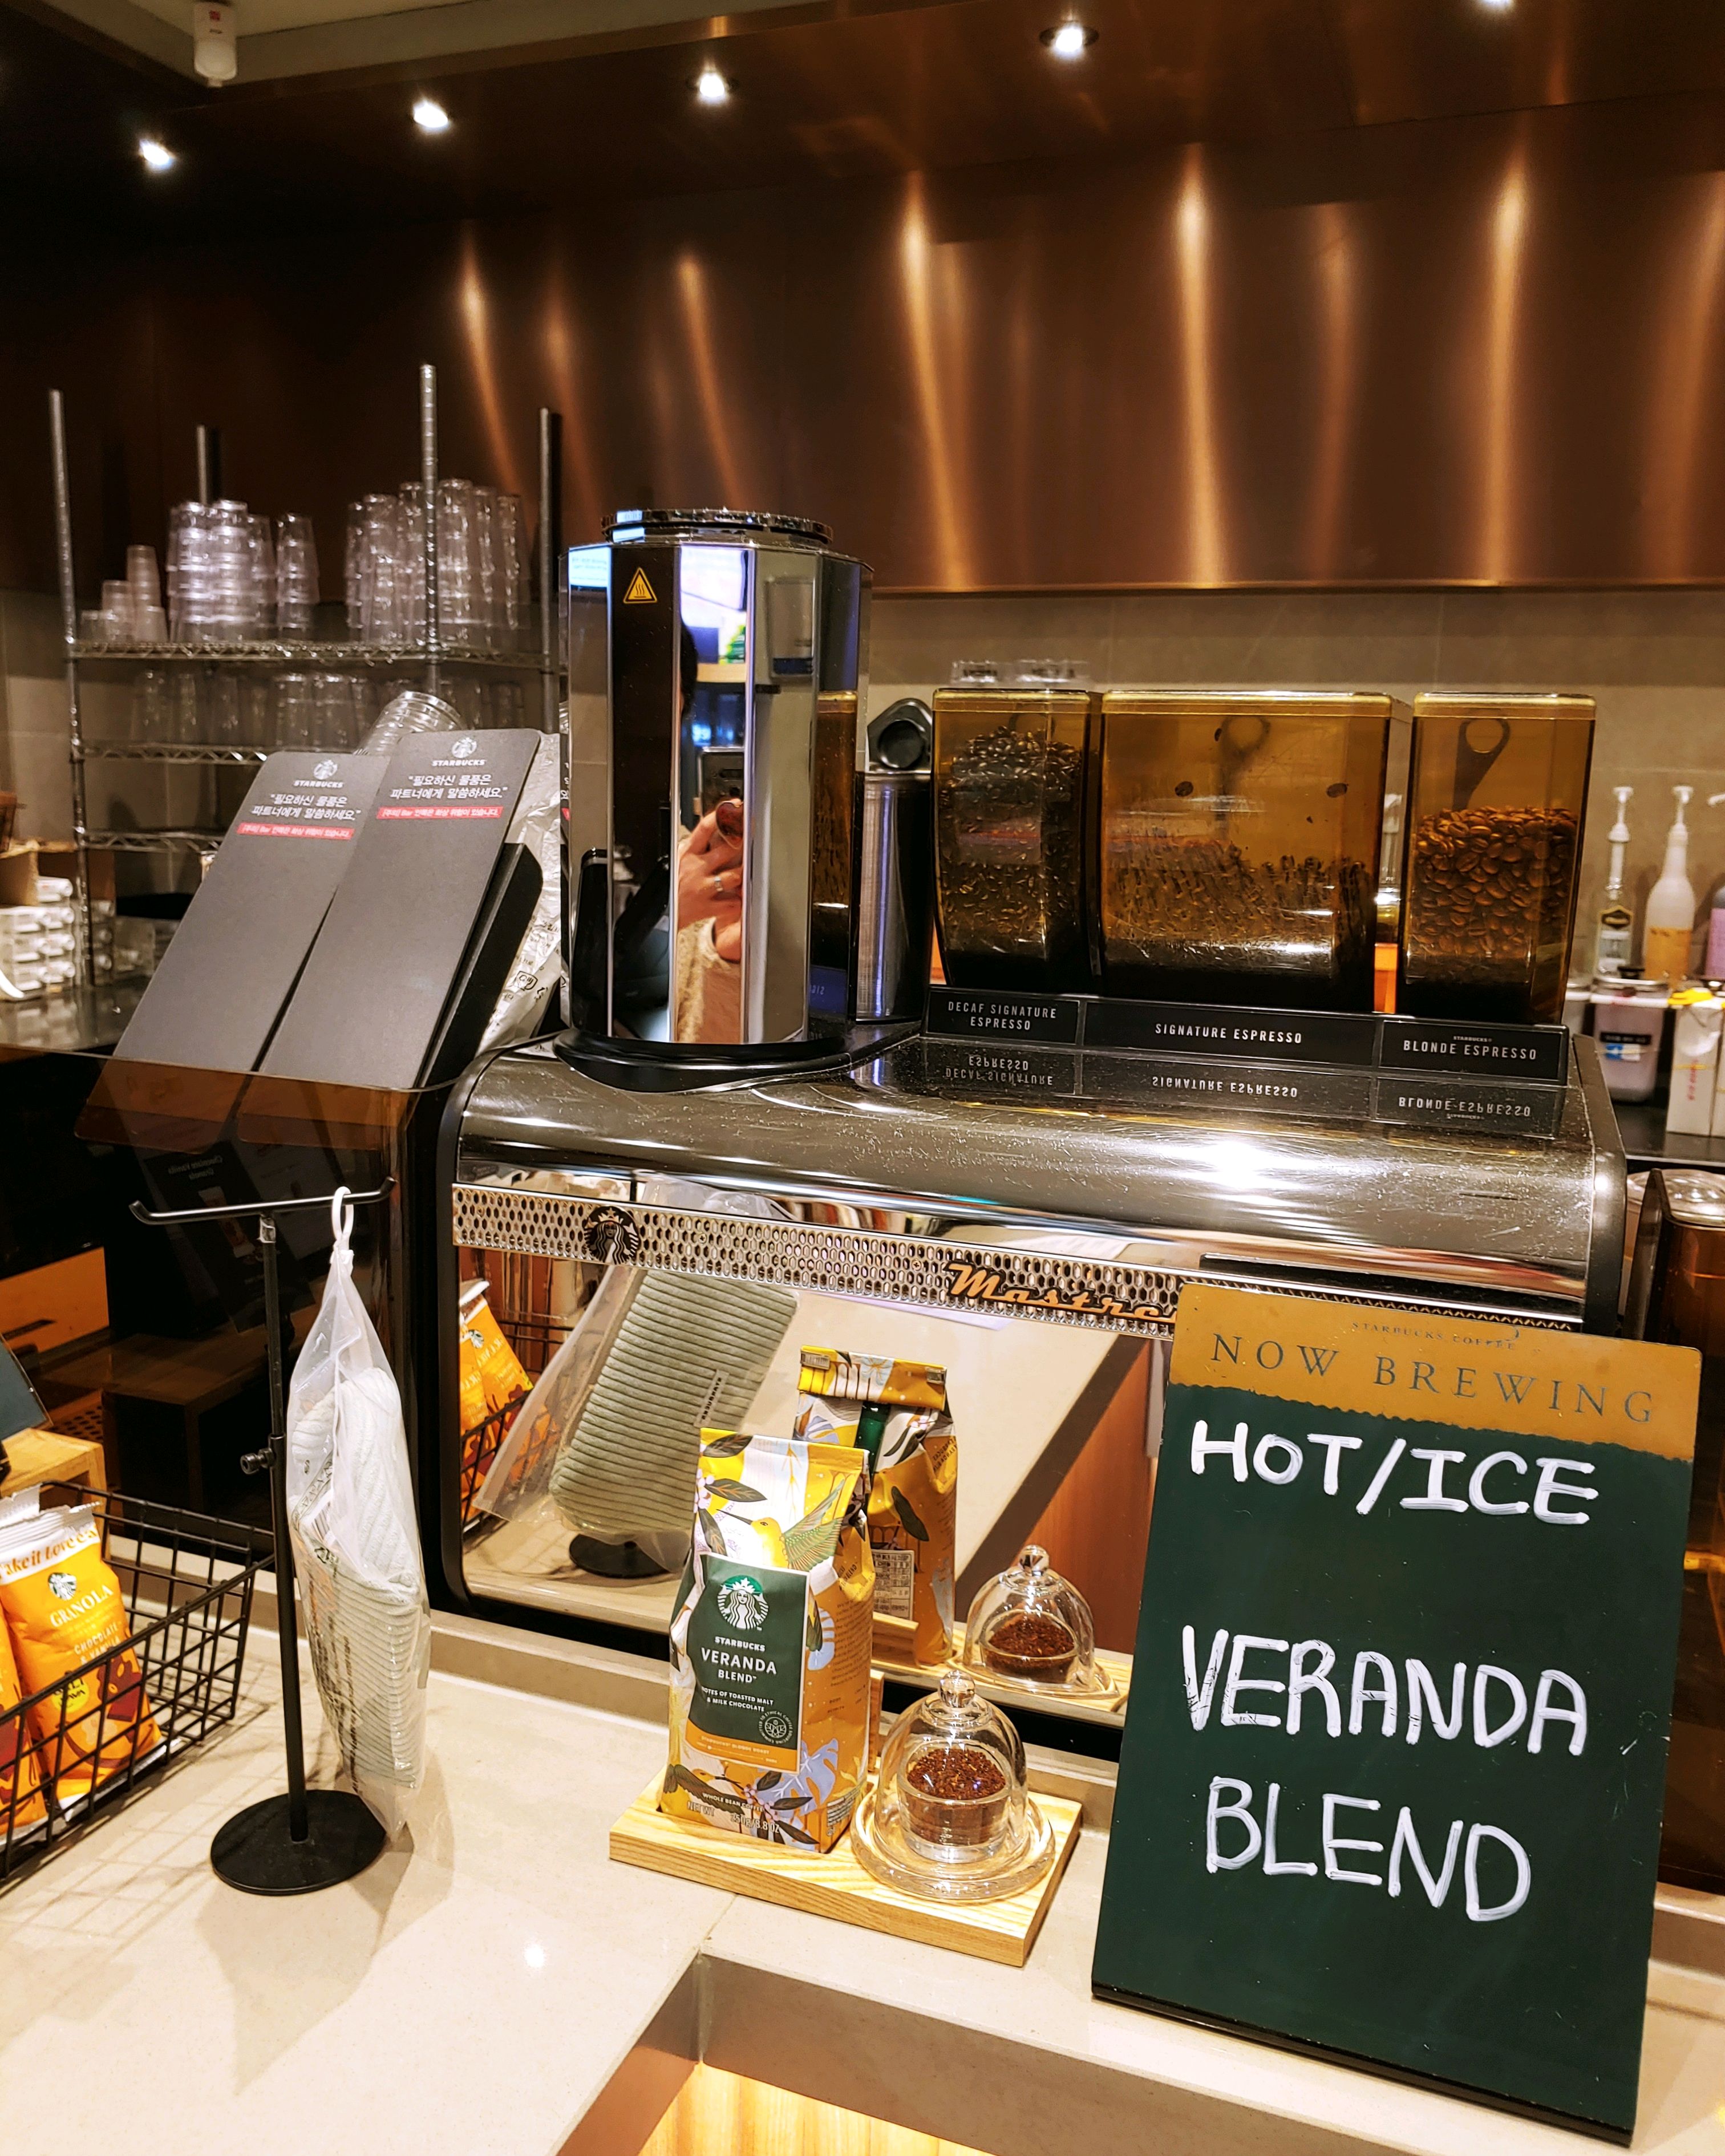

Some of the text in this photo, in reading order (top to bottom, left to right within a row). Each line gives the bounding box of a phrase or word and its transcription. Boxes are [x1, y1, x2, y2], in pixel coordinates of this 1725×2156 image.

[293, 780, 343, 788] STARBUCKS
[458, 774, 492, 786] 물품은
[316, 796, 348, 808] 물품은
[390, 788, 444, 800] 파트너에게
[251, 805, 302, 818] 파트너에게
[948, 1001, 1056, 1019] DECAF SIGNATURE
[970, 1016, 1031, 1030] ESPRESSO
[1155, 1023, 1302, 1044] SIGNATURE ESPRESSO
[1403, 1040, 1536, 1060] BLONDE ESPRESSO
[1352, 1322, 1517, 1351] STARBUCKS COFFEE
[1209, 1333, 1653, 1424] NOW BREWING
[1190, 1419, 1599, 1525] HOT/ICE
[50, 1584, 114, 1627] GRANOLA
[74, 1623, 118, 1655] CHOCOLATE
[715, 1636, 766, 1652] STARBUCKS
[700, 1647, 777, 1675] VERANDA
[729, 1692, 755, 1703] TOASTED
[1182, 1624, 1588, 1756] VERANDA
[728, 1700, 765, 1712] CHOCOLATE
[687, 1801, 702, 1813] NET
[702, 1806, 715, 1817] WT
[702, 1792, 764, 1812] WHOLE BEAN COFFEE
[1206, 1776, 1532, 1922] BLEND
